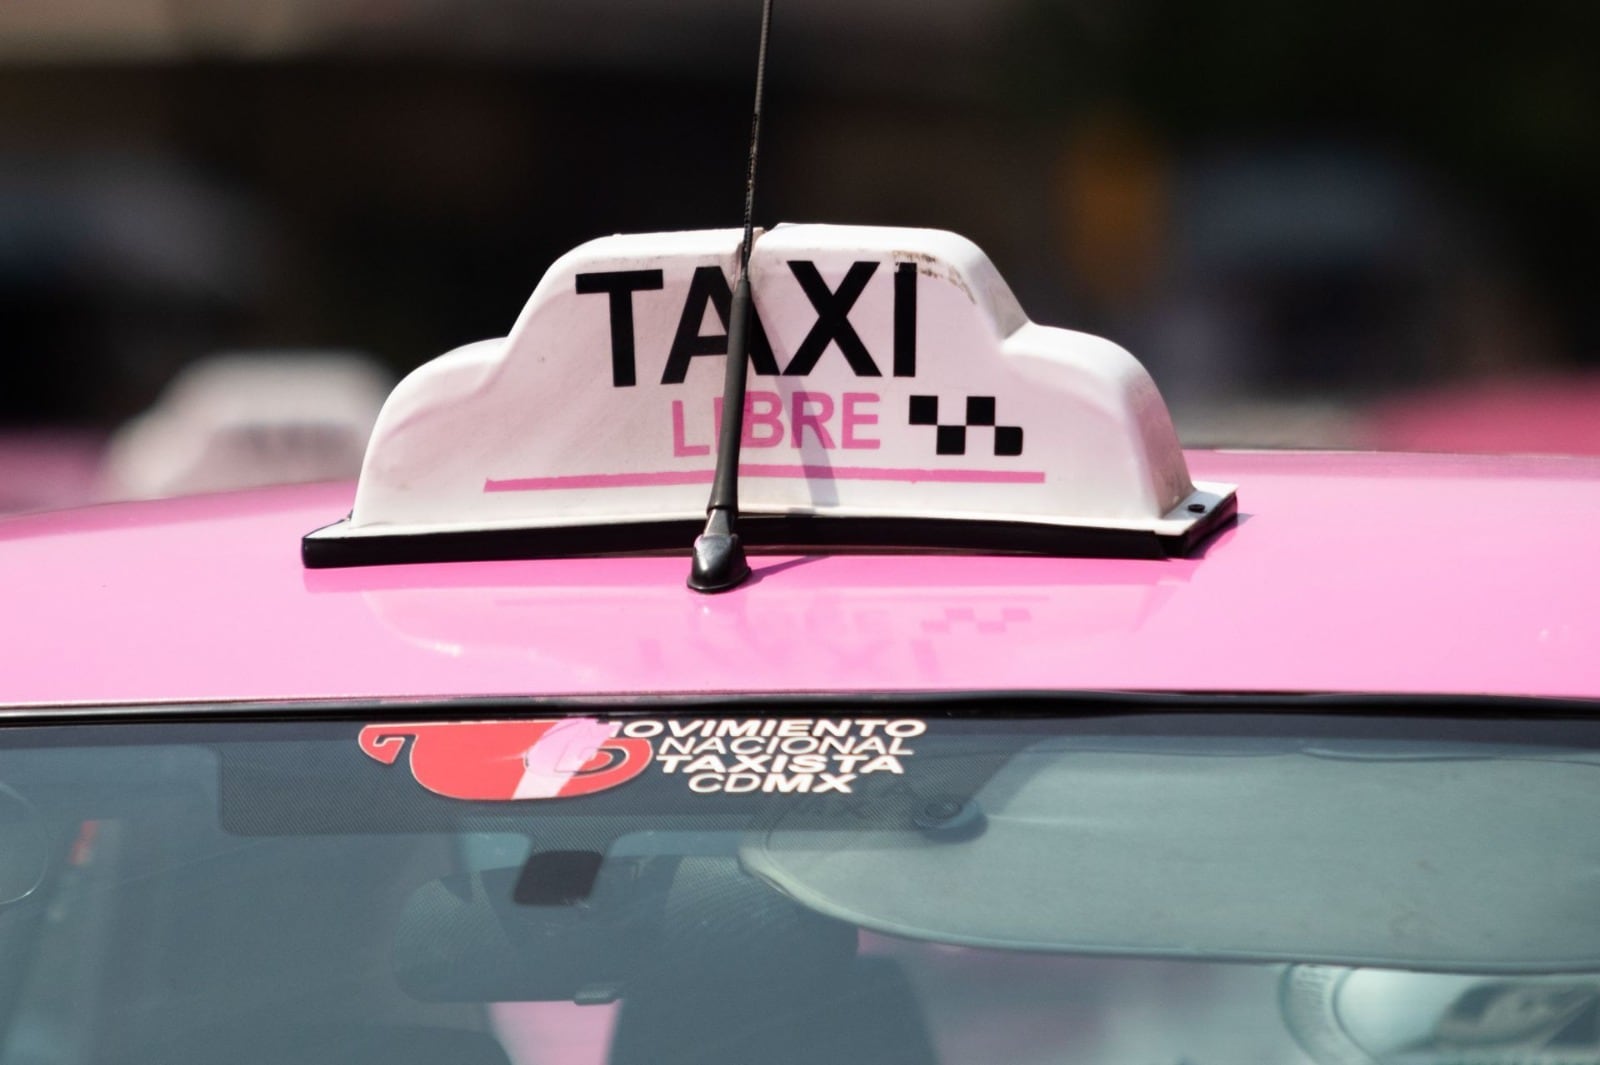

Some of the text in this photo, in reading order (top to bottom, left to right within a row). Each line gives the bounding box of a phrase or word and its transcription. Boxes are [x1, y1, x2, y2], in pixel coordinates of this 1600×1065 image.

[575, 260, 917, 388] TAXI
[671, 390, 881, 458] LIBRE
[658, 736, 915, 755] NACIONAL
[656, 754, 905, 774] TAXISTA
[688, 773, 857, 793] CDMX
